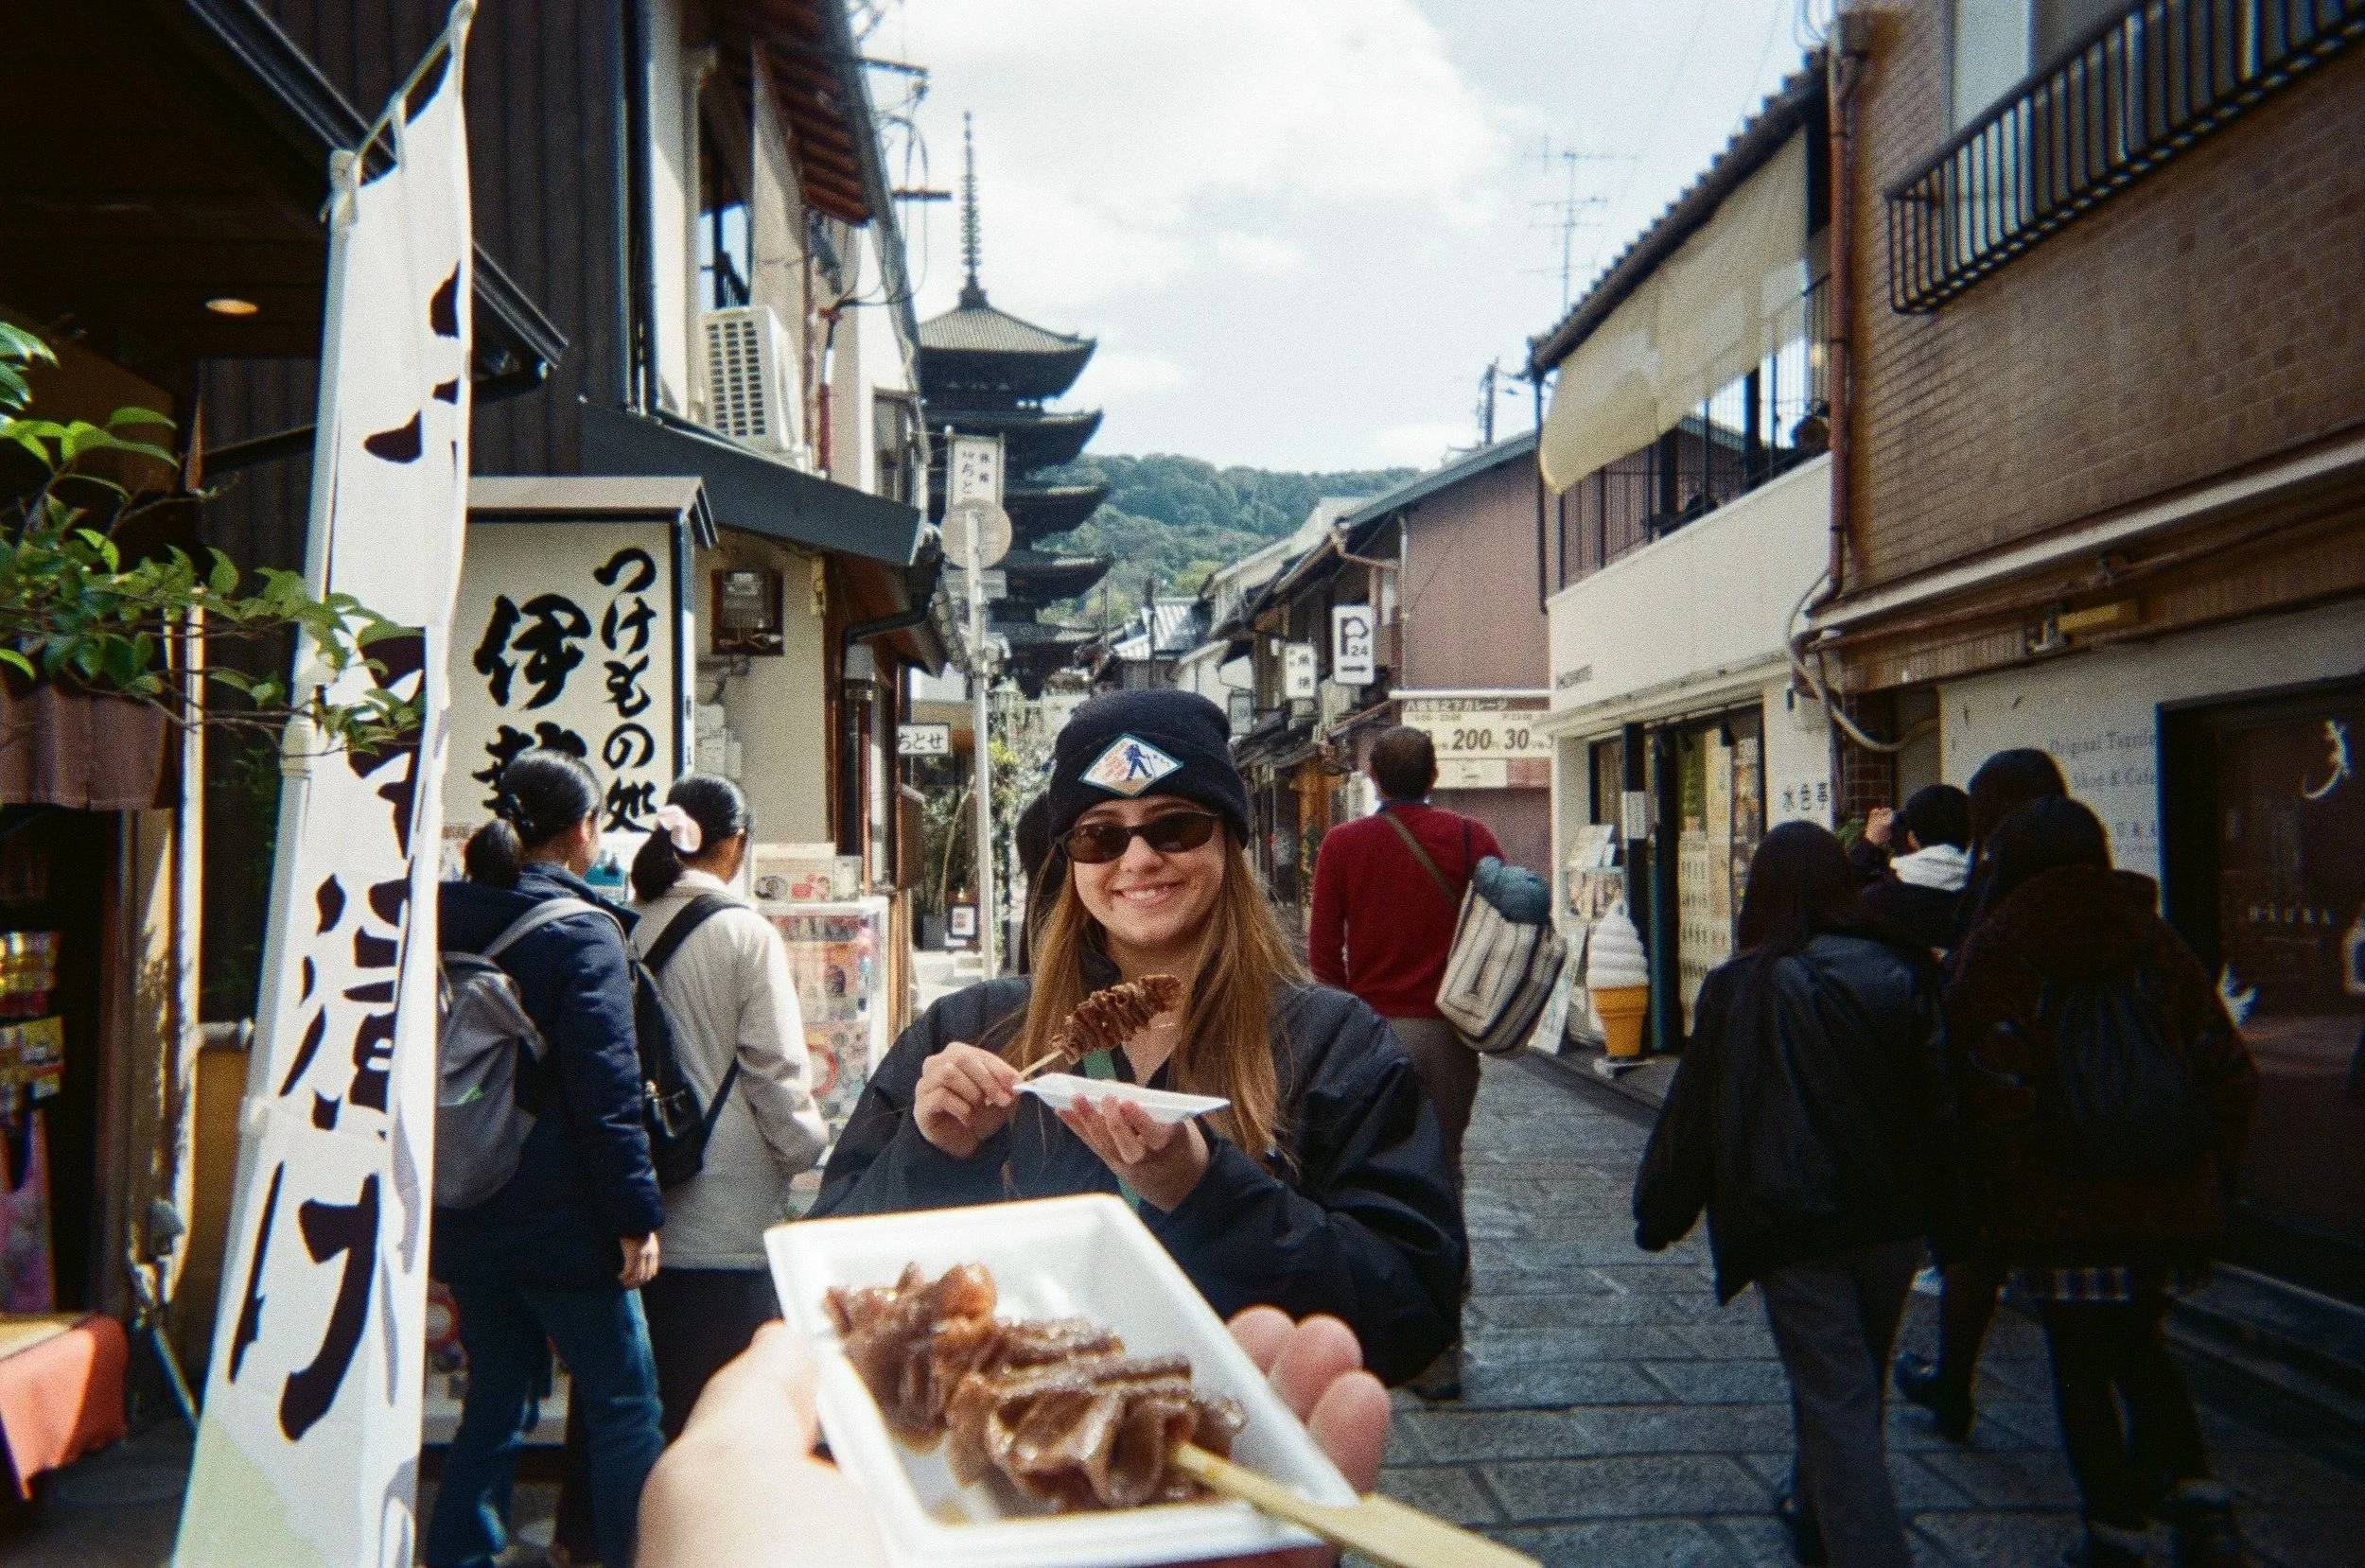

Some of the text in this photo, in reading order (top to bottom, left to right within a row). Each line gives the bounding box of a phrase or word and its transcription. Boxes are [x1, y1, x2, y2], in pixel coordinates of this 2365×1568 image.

[1340, 616, 1369, 656] P
[1351, 645, 1368, 656] 24
[594, 549, 657, 833] つけもの処
[1452, 728, 1493, 750] 200
[1504, 728, 1530, 750] 30
